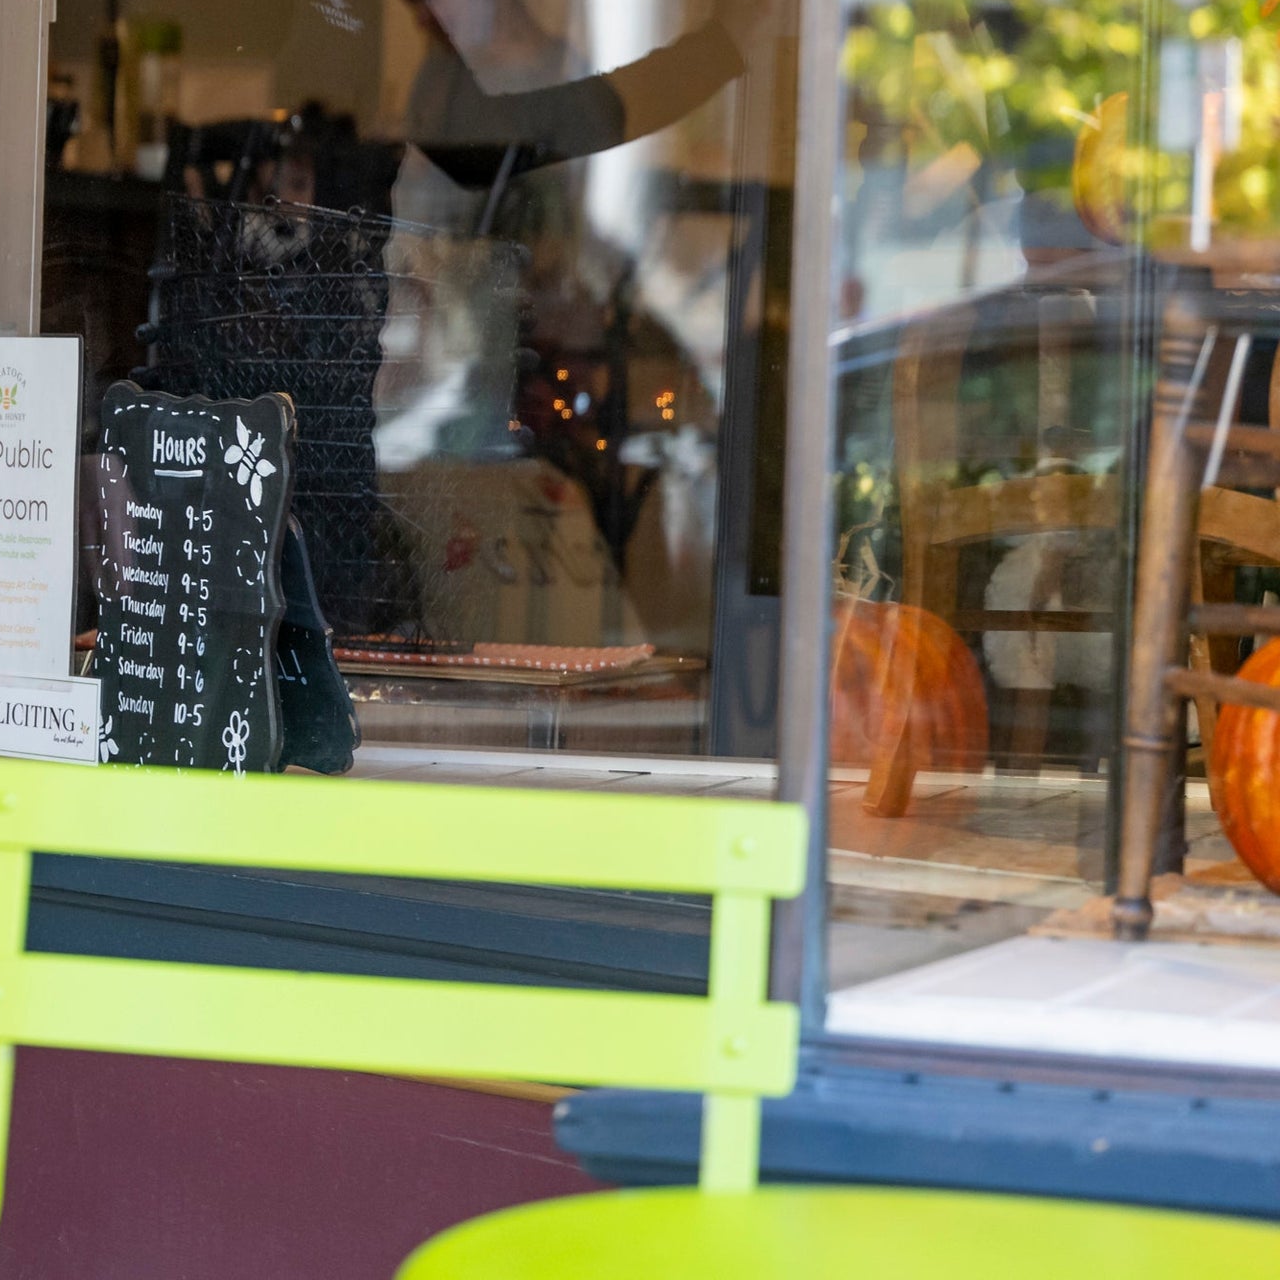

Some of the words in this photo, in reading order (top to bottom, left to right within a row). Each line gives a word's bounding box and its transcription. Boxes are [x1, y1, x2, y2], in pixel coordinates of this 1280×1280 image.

[152, 429, 207, 466] HOURS
[127, 501, 162, 529] Monday
[186, 506, 213, 531] 9-5
[123, 531, 164, 566] Tuesday
[183, 539, 212, 565] 9-5
[123, 566, 169, 594] Wednesday
[181, 573, 209, 601] 9-5
[120, 595, 166, 625] Thursday
[179, 603, 207, 626] 9-5
[121, 623, 154, 658] Friday
[177, 632, 205, 656] 9-6
[118, 656, 165, 689] Saturday
[177, 664, 204, 693] 9-6
[118, 691, 154, 724] Sunday
[174, 703, 204, 727] 10-5
